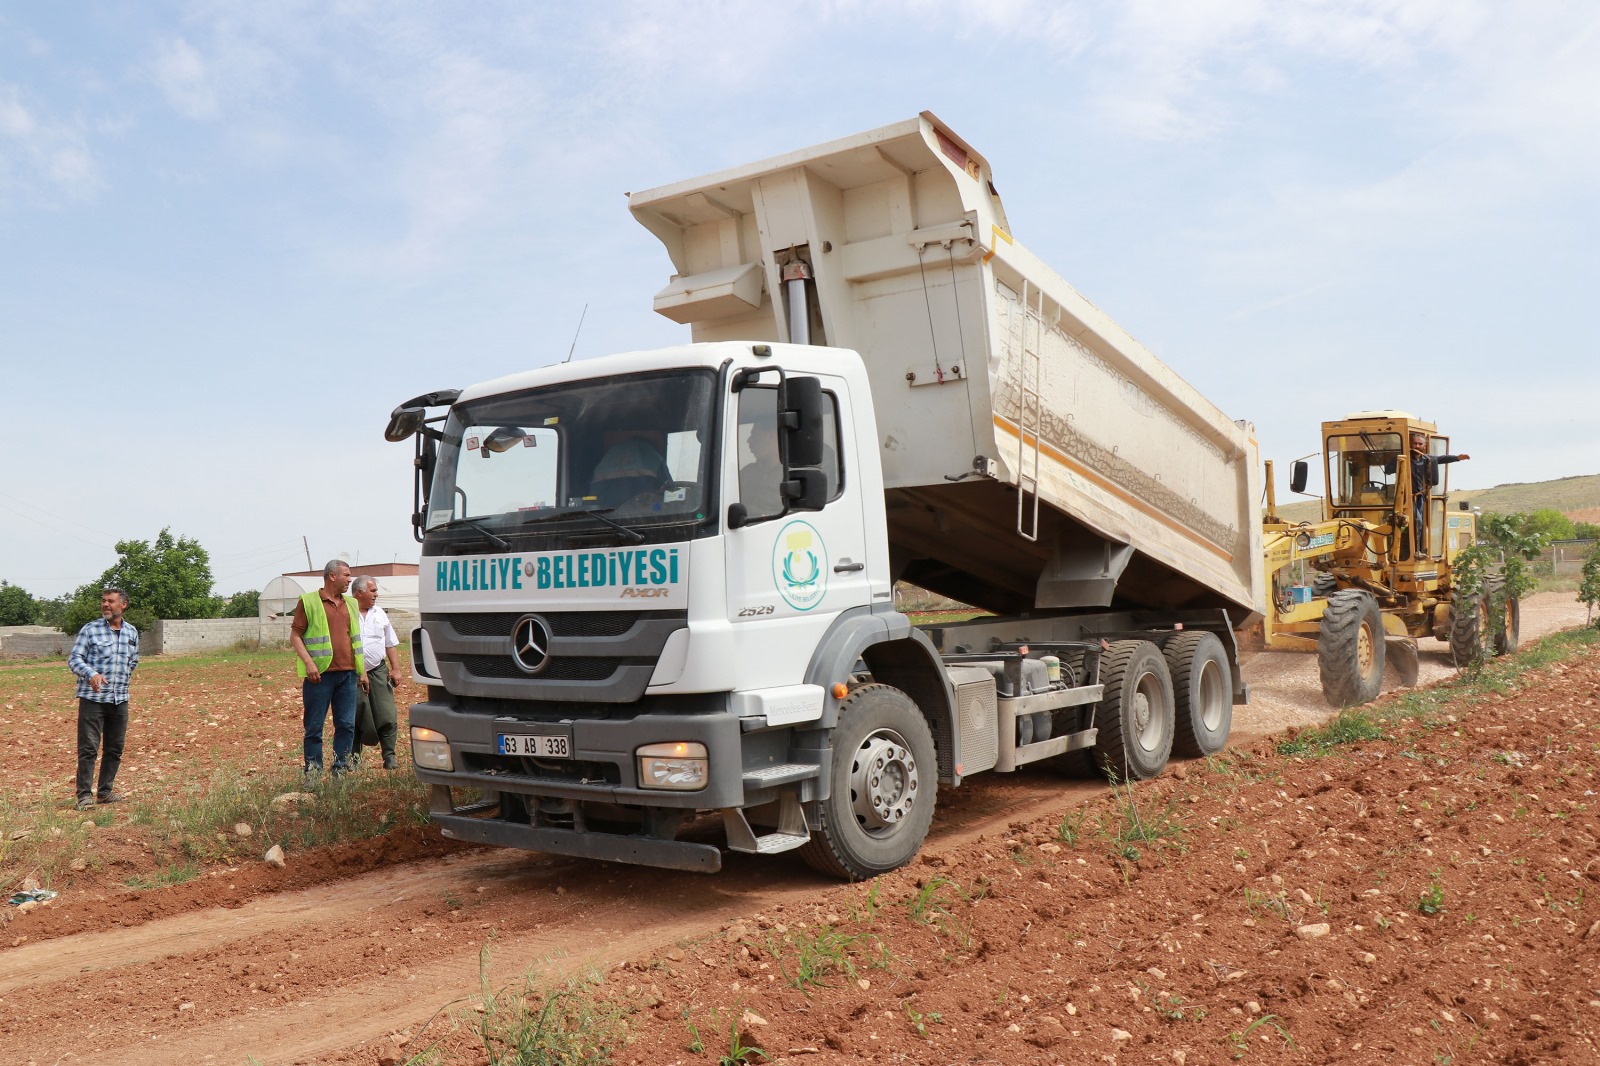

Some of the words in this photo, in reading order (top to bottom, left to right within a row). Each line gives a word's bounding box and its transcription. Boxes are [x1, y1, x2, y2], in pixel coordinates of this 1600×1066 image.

[620, 587, 669, 598] AXOR
[738, 604, 775, 617] 2529
[504, 737, 517, 753] 63
[524, 738, 537, 754] AB
[546, 738, 567, 755] 338
